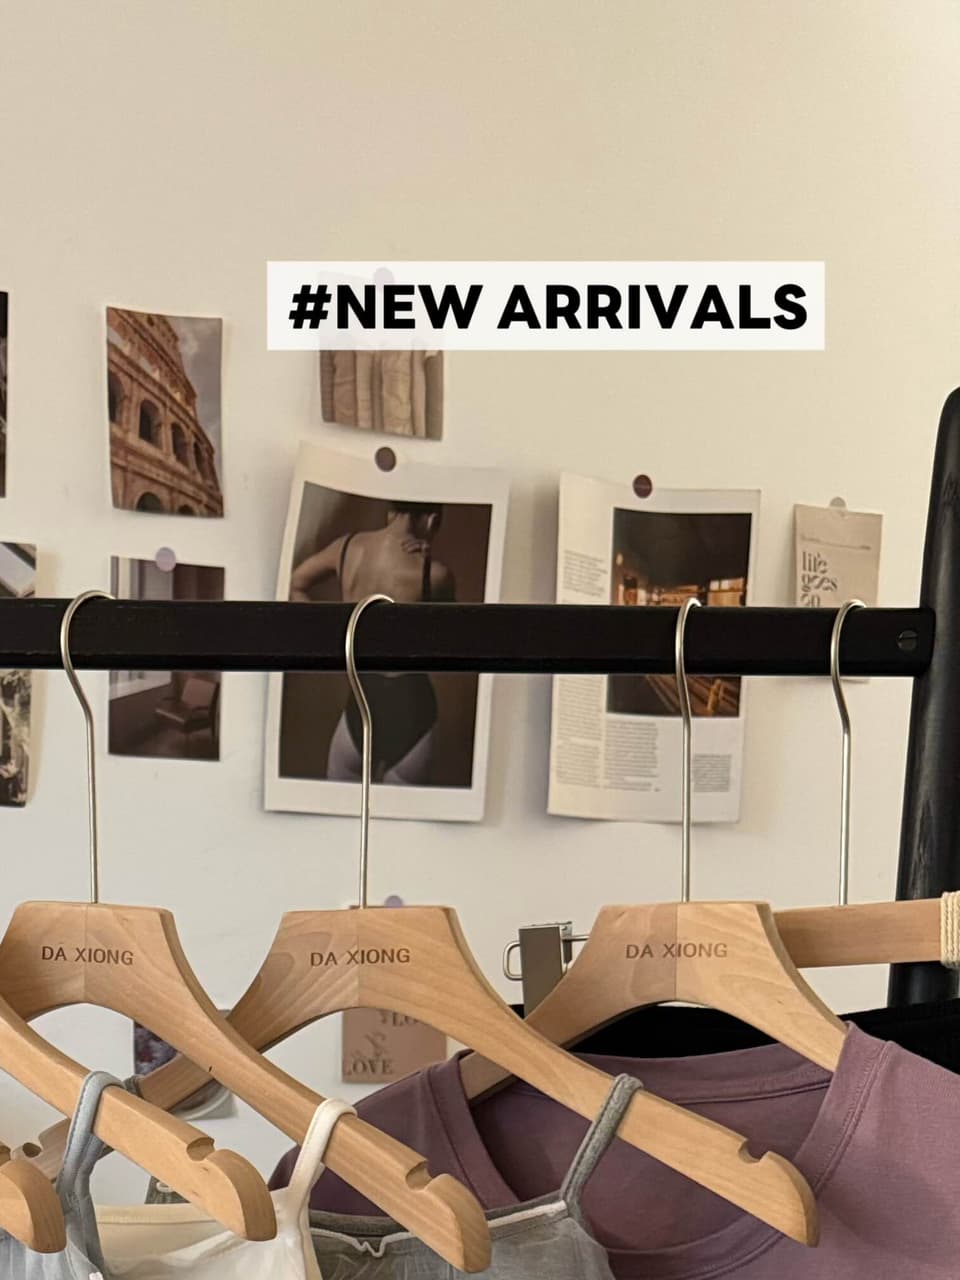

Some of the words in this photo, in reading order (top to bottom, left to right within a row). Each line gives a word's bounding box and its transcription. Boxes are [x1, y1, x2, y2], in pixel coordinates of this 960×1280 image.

[41, 946, 67, 961] DA
[75, 947, 134, 966] XIONG
[310, 951, 338, 966] DA
[346, 948, 411, 965] XIONG
[626, 944, 653, 959] DA
[662, 942, 728, 959] XIONG
